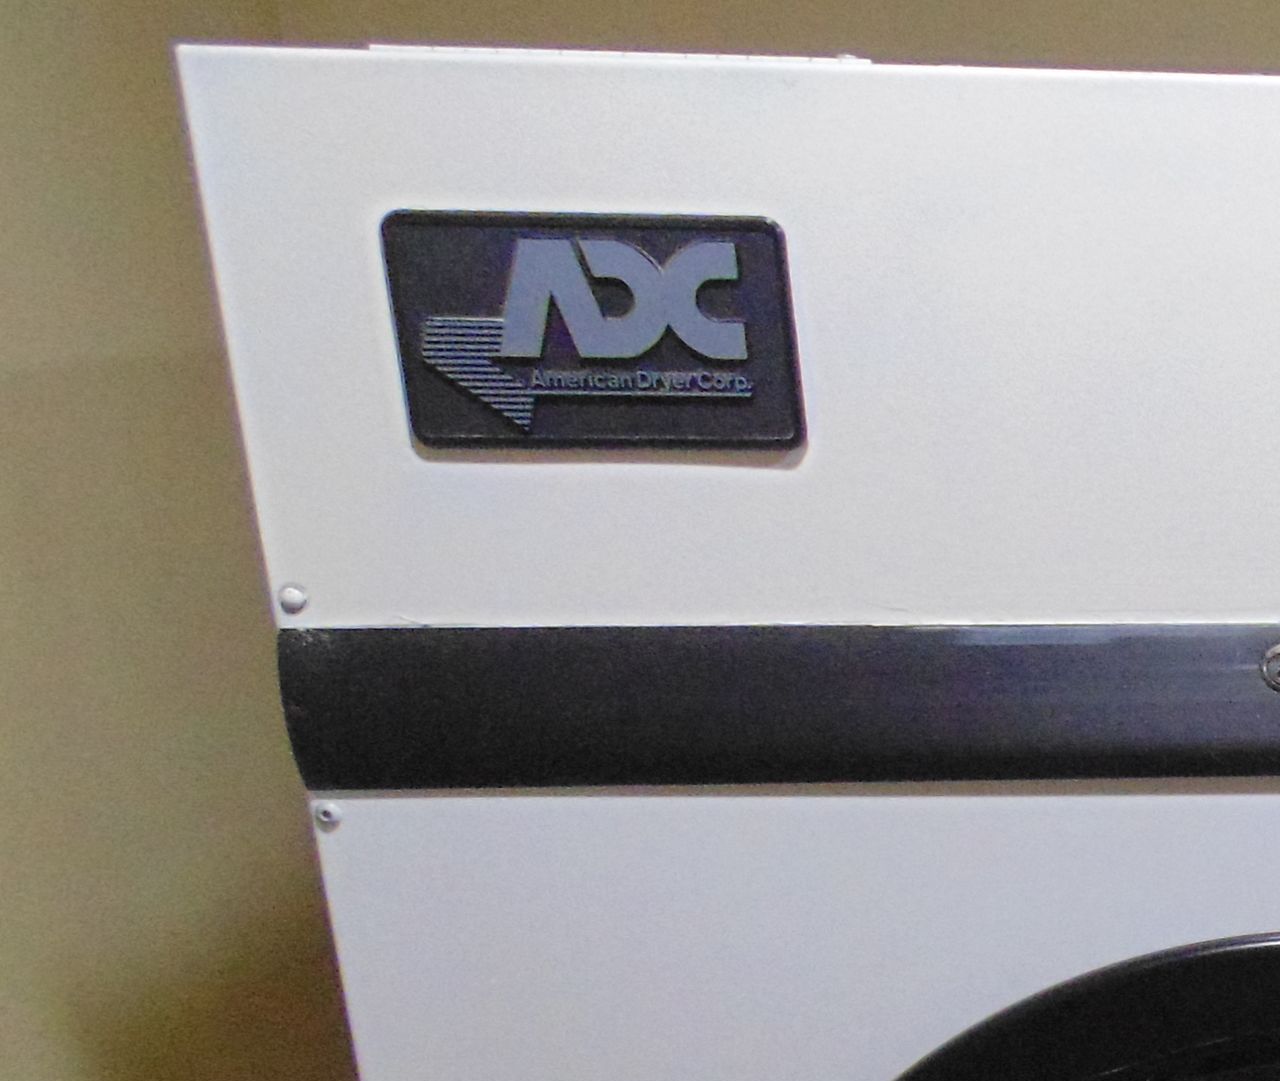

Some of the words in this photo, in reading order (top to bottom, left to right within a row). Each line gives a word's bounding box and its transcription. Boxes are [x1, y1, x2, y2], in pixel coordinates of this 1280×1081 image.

[499, 238, 748, 360] ADC
[531, 369, 634, 389] American
[635, 370, 692, 391] Dryer
[698, 371, 752, 393] Corp.
